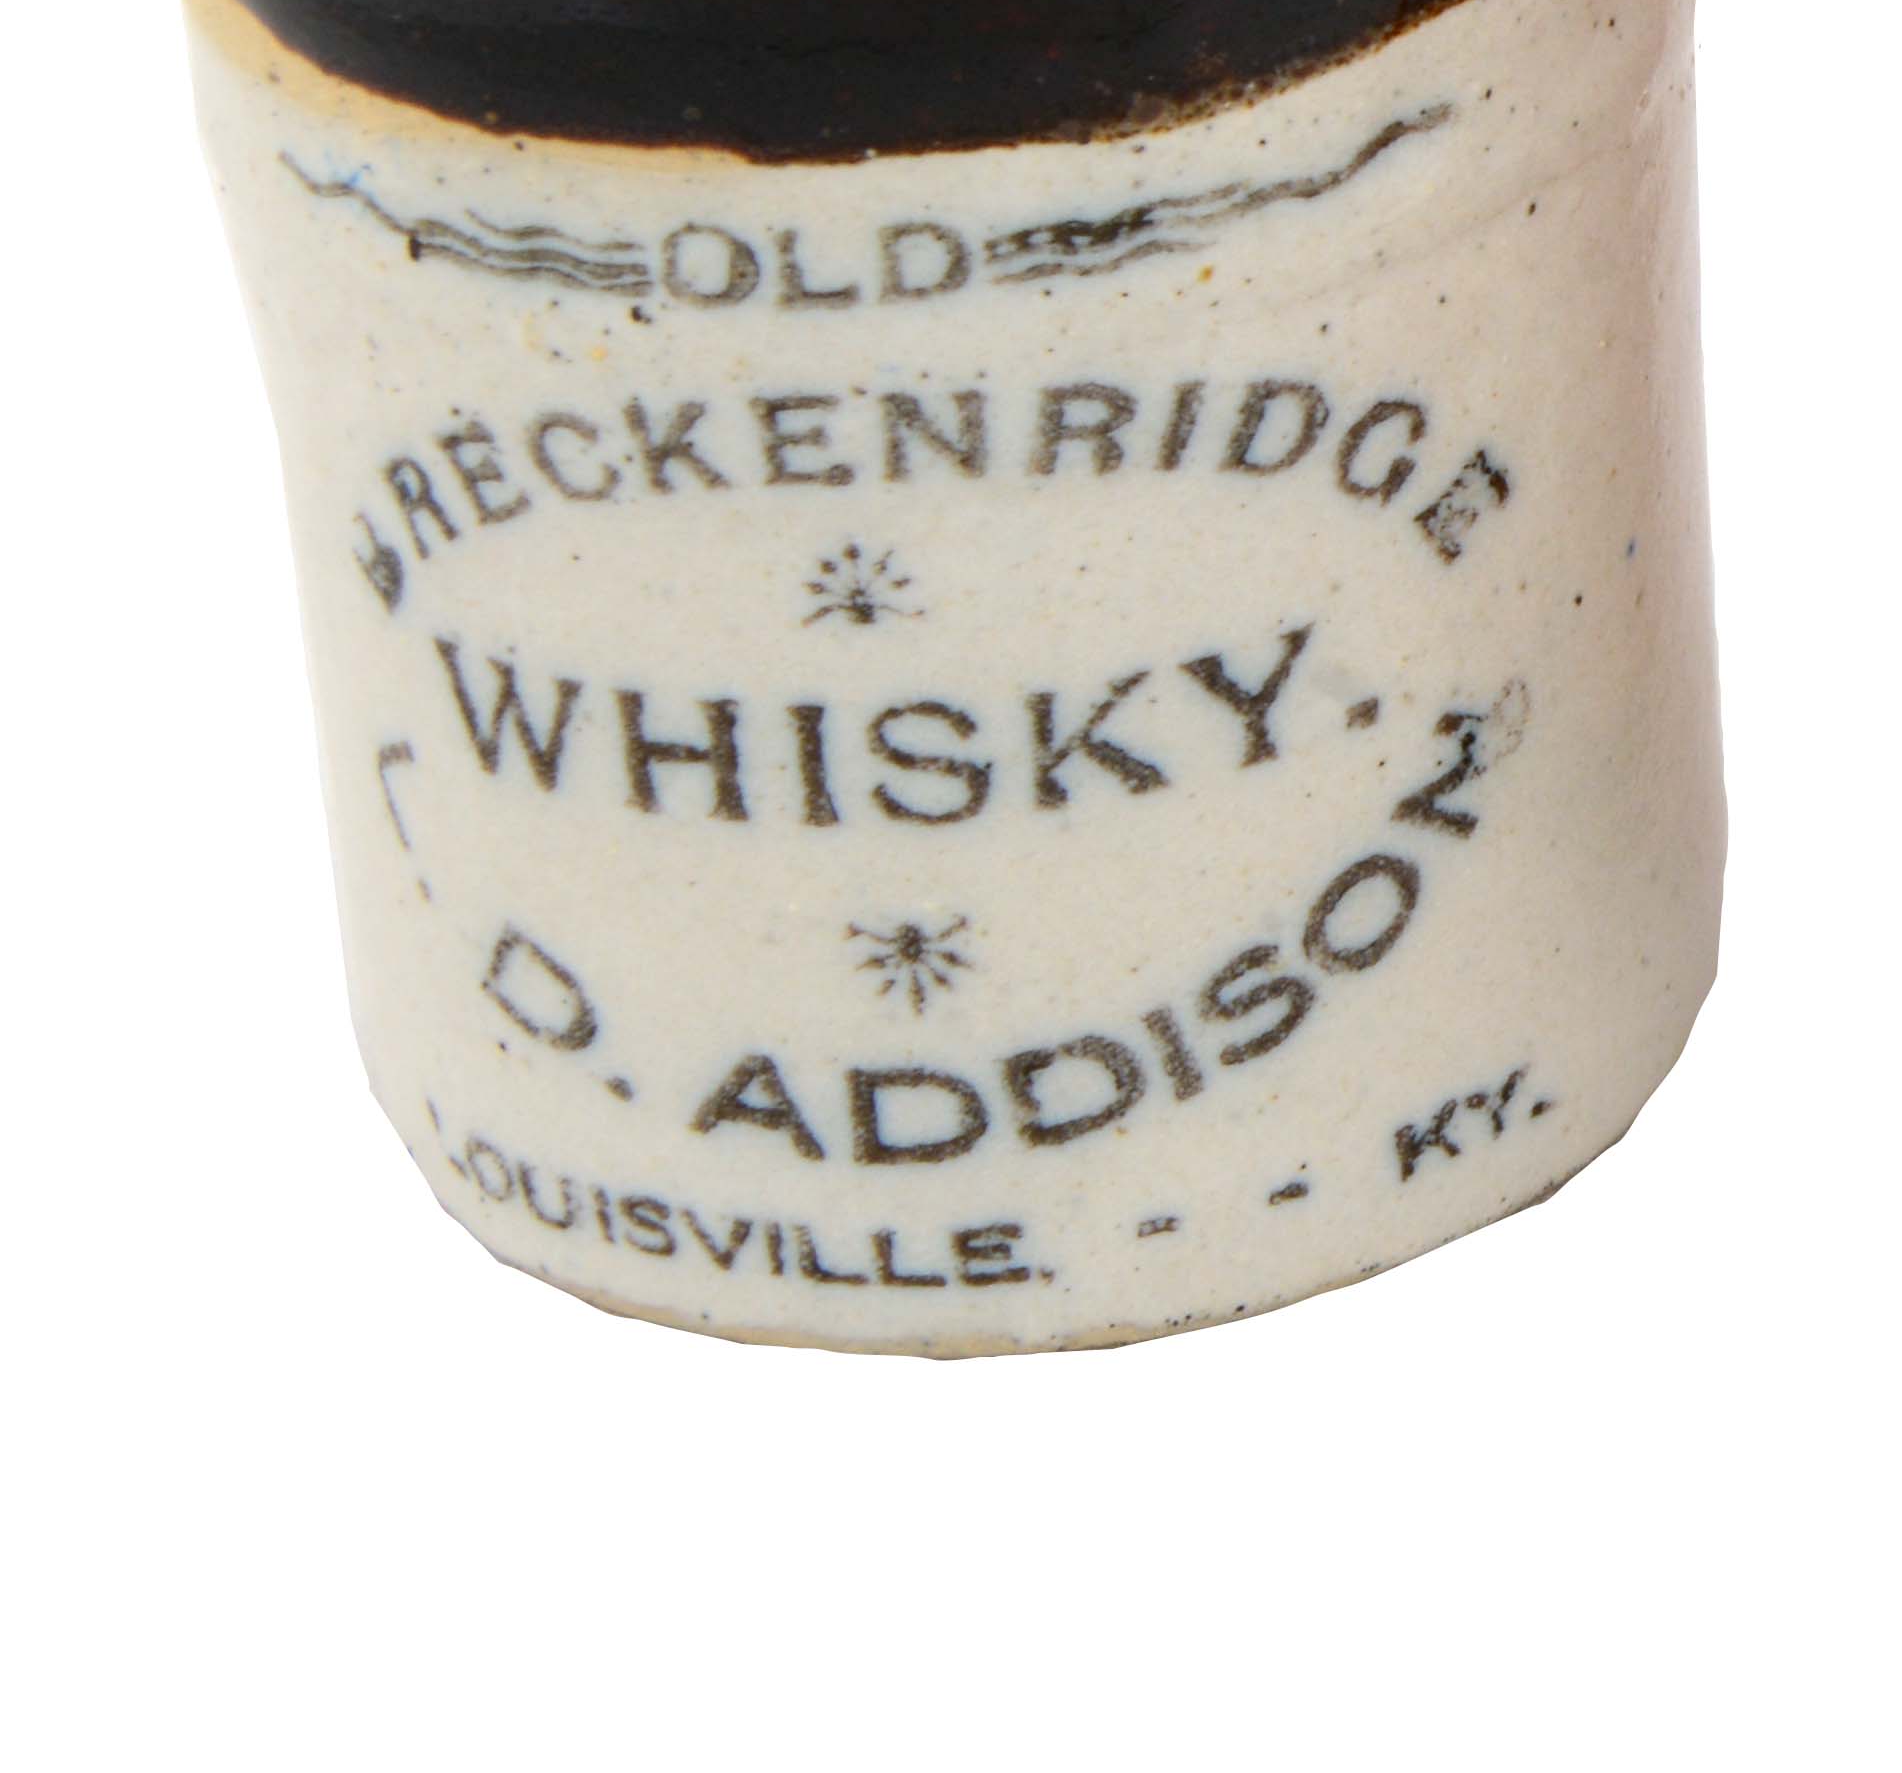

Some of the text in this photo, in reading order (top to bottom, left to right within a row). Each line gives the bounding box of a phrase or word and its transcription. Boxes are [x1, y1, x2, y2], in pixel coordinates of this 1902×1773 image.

[660, 219, 974, 310] OLD
[434, 620, 1381, 828] WHISKY.
[482, 920, 634, 1102] D.
[692, 680, 1530, 1166] ADDISON
[1394, 1066, 1553, 1182] KY.
